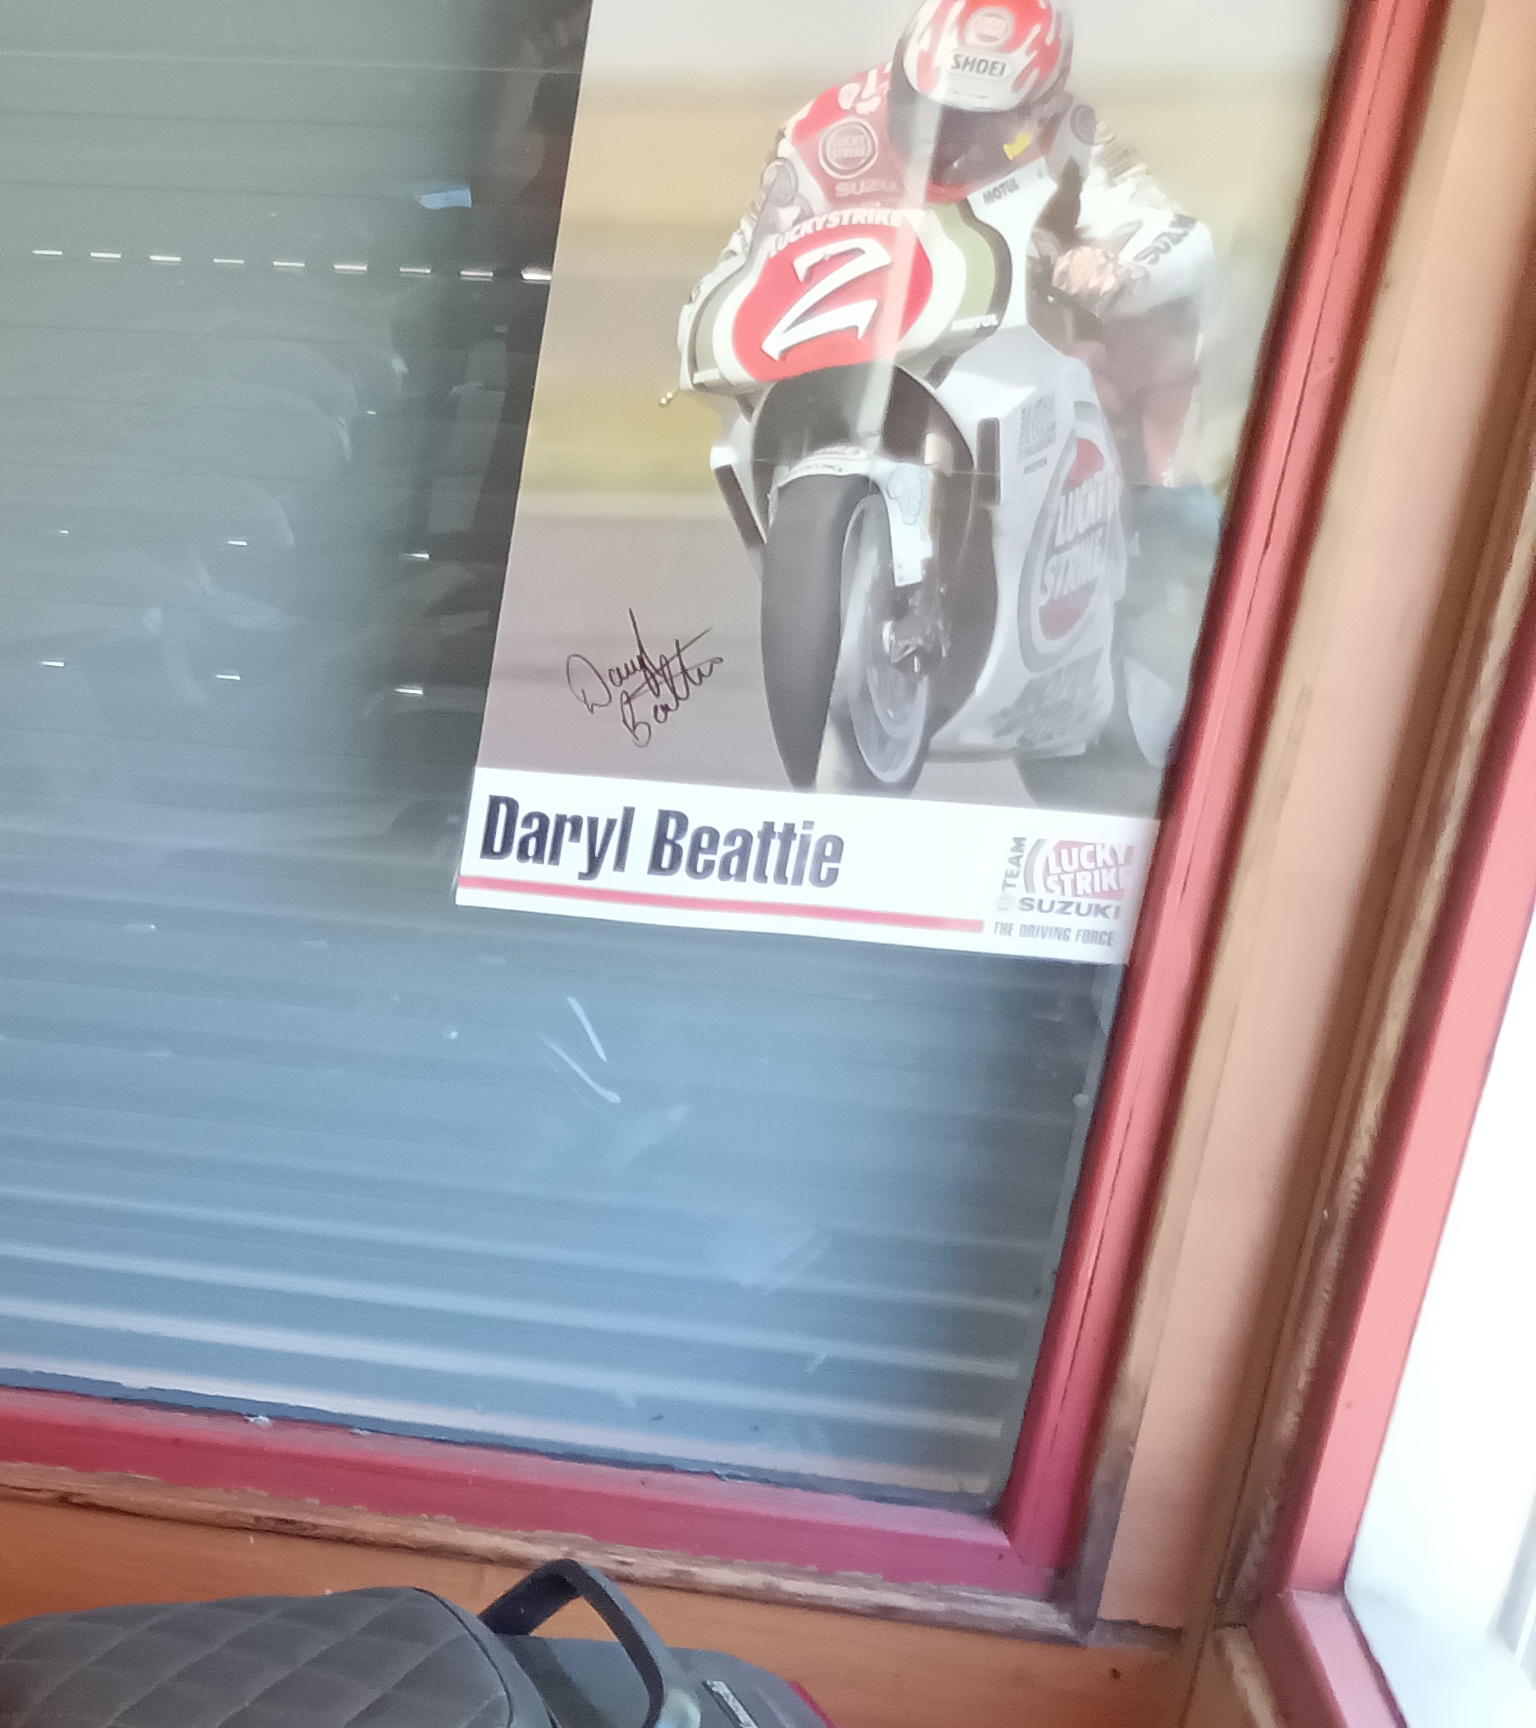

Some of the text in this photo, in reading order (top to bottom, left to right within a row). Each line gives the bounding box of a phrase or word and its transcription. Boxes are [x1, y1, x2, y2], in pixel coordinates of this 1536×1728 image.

[951, 53, 1007, 77] SHOEI
[982, 177, 1020, 206] MOTUL
[761, 240, 893, 363] 2
[479, 794, 845, 889] Daryl Beattie
[1001, 836, 1027, 891] TEAM
[1047, 843, 1130, 875] LUCKY
[1017, 896, 1122, 920] SUZUKI
[994, 921, 1115, 947] THE DRIVING FORCE
